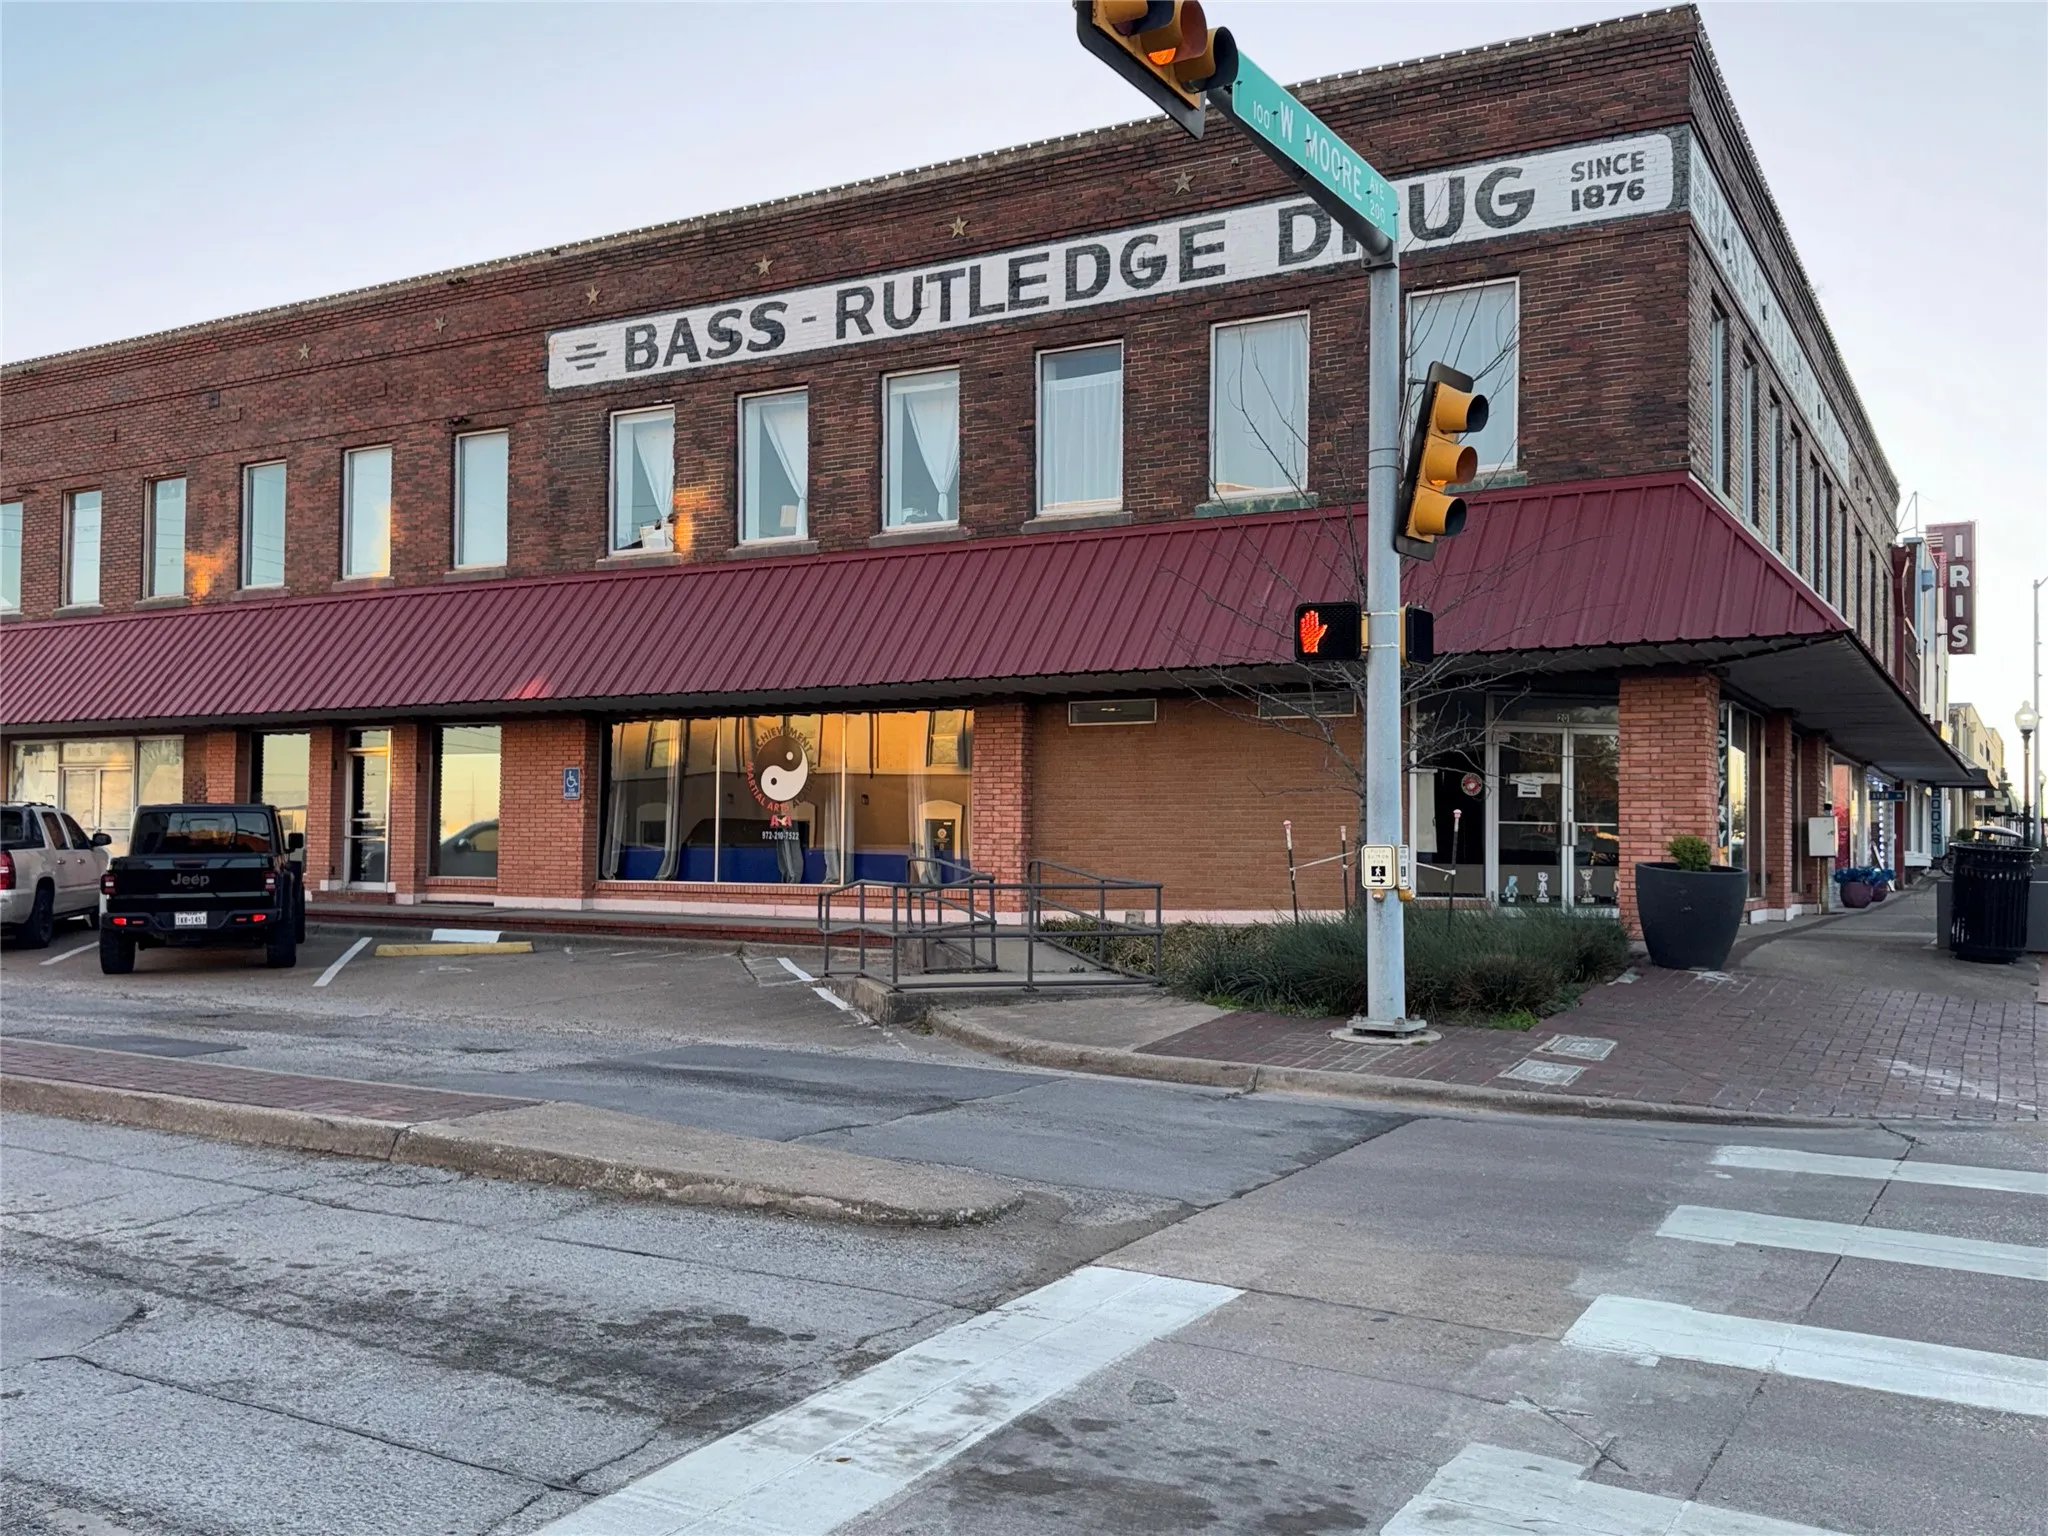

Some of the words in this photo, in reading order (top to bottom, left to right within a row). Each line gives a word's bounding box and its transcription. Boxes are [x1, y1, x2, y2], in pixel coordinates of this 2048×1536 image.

[1253, 101, 1270, 129] 100
[1280, 101, 1293, 143] W
[1305, 124, 1362, 201] MOORE
[1369, 175, 1385, 200] AVE
[1571, 150, 1645, 183] SINCE
[1369, 199, 1386, 224] 200
[1571, 178, 1645, 212] 1876
[625, 302, 788, 373] BASS
[835, 218, 1226, 340] RUTLEDGE
[1948, 534, 1971, 648] IRIS
[755, 725, 813, 753] CHIEVMENT
[746, 761, 766, 807] MARTIAL
[767, 801, 790, 813] ARTS
[171, 873, 210, 887] Jeep
